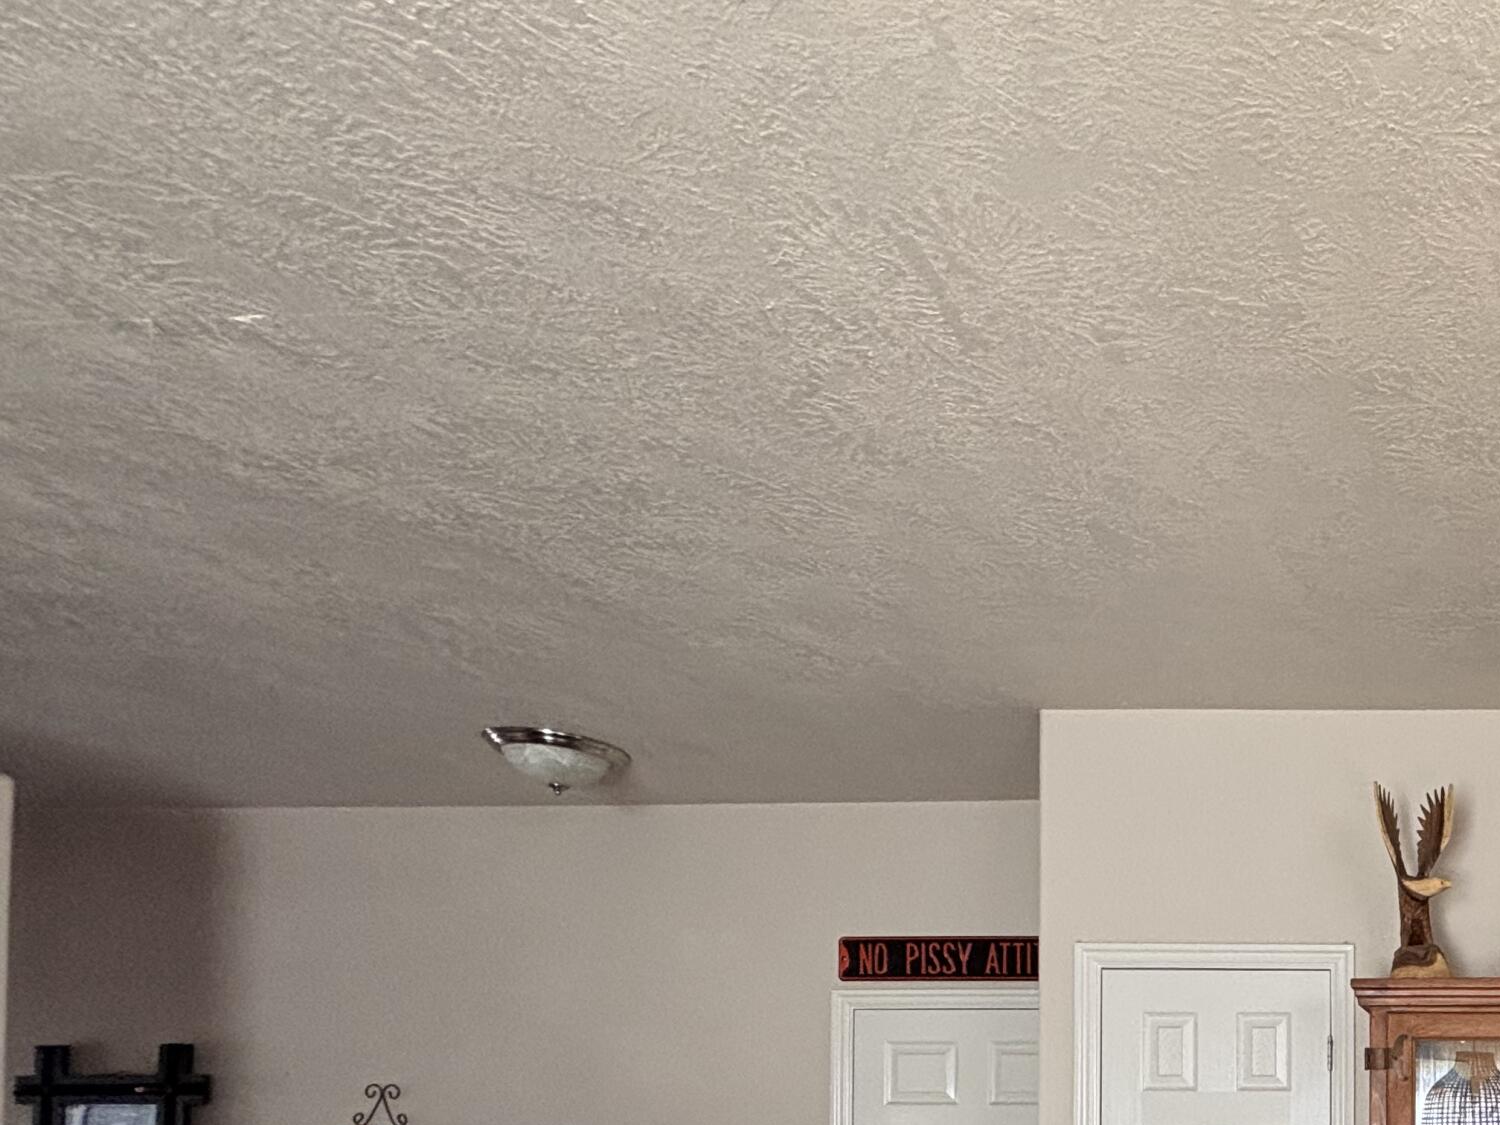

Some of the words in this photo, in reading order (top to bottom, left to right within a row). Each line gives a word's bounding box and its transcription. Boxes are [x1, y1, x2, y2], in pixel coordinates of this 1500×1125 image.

[858, 943, 888, 975] NO
[905, 942, 973, 975] PISSY
[984, 943, 1038, 975] ATTI
